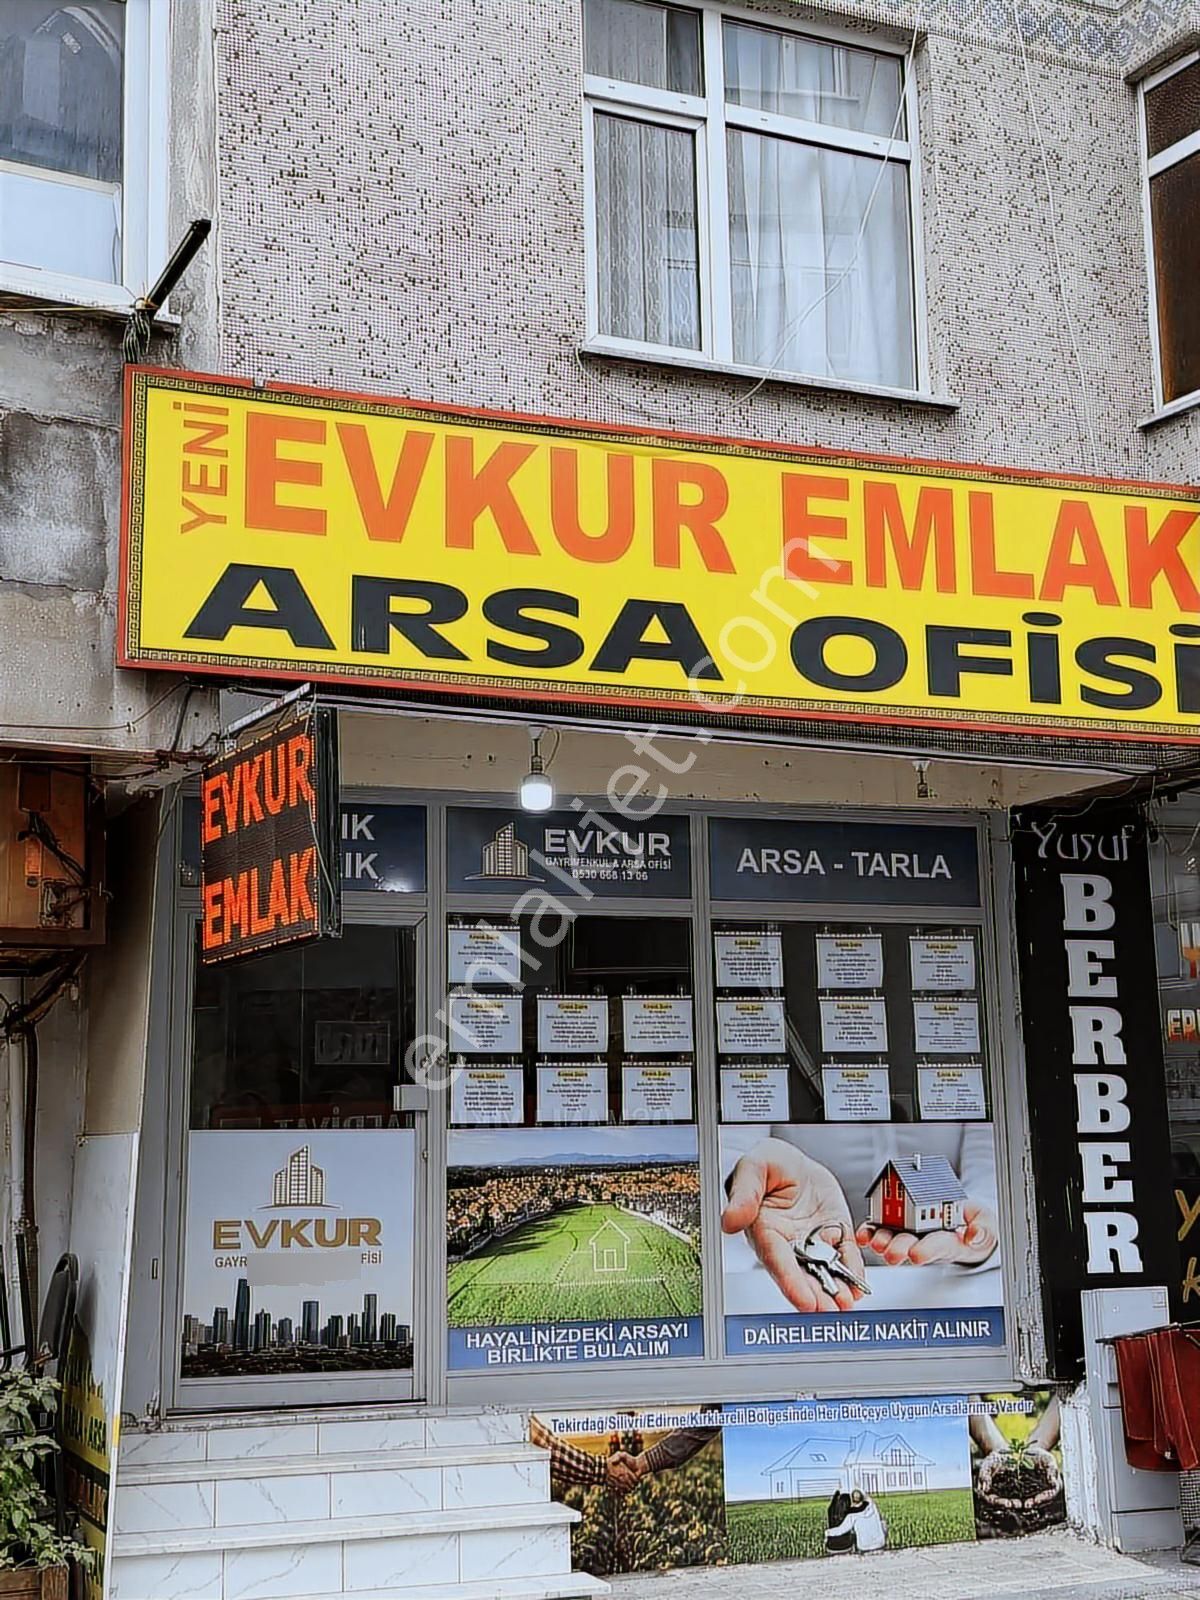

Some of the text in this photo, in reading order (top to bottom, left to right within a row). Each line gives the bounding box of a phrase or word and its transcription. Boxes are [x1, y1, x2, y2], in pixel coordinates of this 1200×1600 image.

[244, 411, 1200, 614] EVKUR EMLAK
[183, 562, 724, 681] ARSA
[204, 733, 314, 844] EVKUR
[544, 828, 672, 856] EVKUR
[621, 859, 646, 869] ARSA
[736, 847, 826, 875] ARSA
[851, 851, 952, 879] TARLA
[204, 845, 316, 949] EMLAK
[1059, 873, 1144, 1274] BERBER
[213, 1217, 383, 1250] EVKUR
[466, 1323, 689, 1349] HAYALİNİZDEKİ ARSAYI
[743, 1318, 991, 1345] DAİRELERİNİZ NAKİT ALINIR
[486, 1341, 669, 1365] BİRLİKTE BULALIM
[747, 1407, 814, 1426] Bölgesinde
[817, 1405, 838, 1420] Her
[841, 1403, 888, 1422] Bütçeye
[891, 1402, 928, 1421] Uygun
[931, 1401, 997, 1415] Arsalarımız
[998, 1398, 1034, 1413] Vardır
